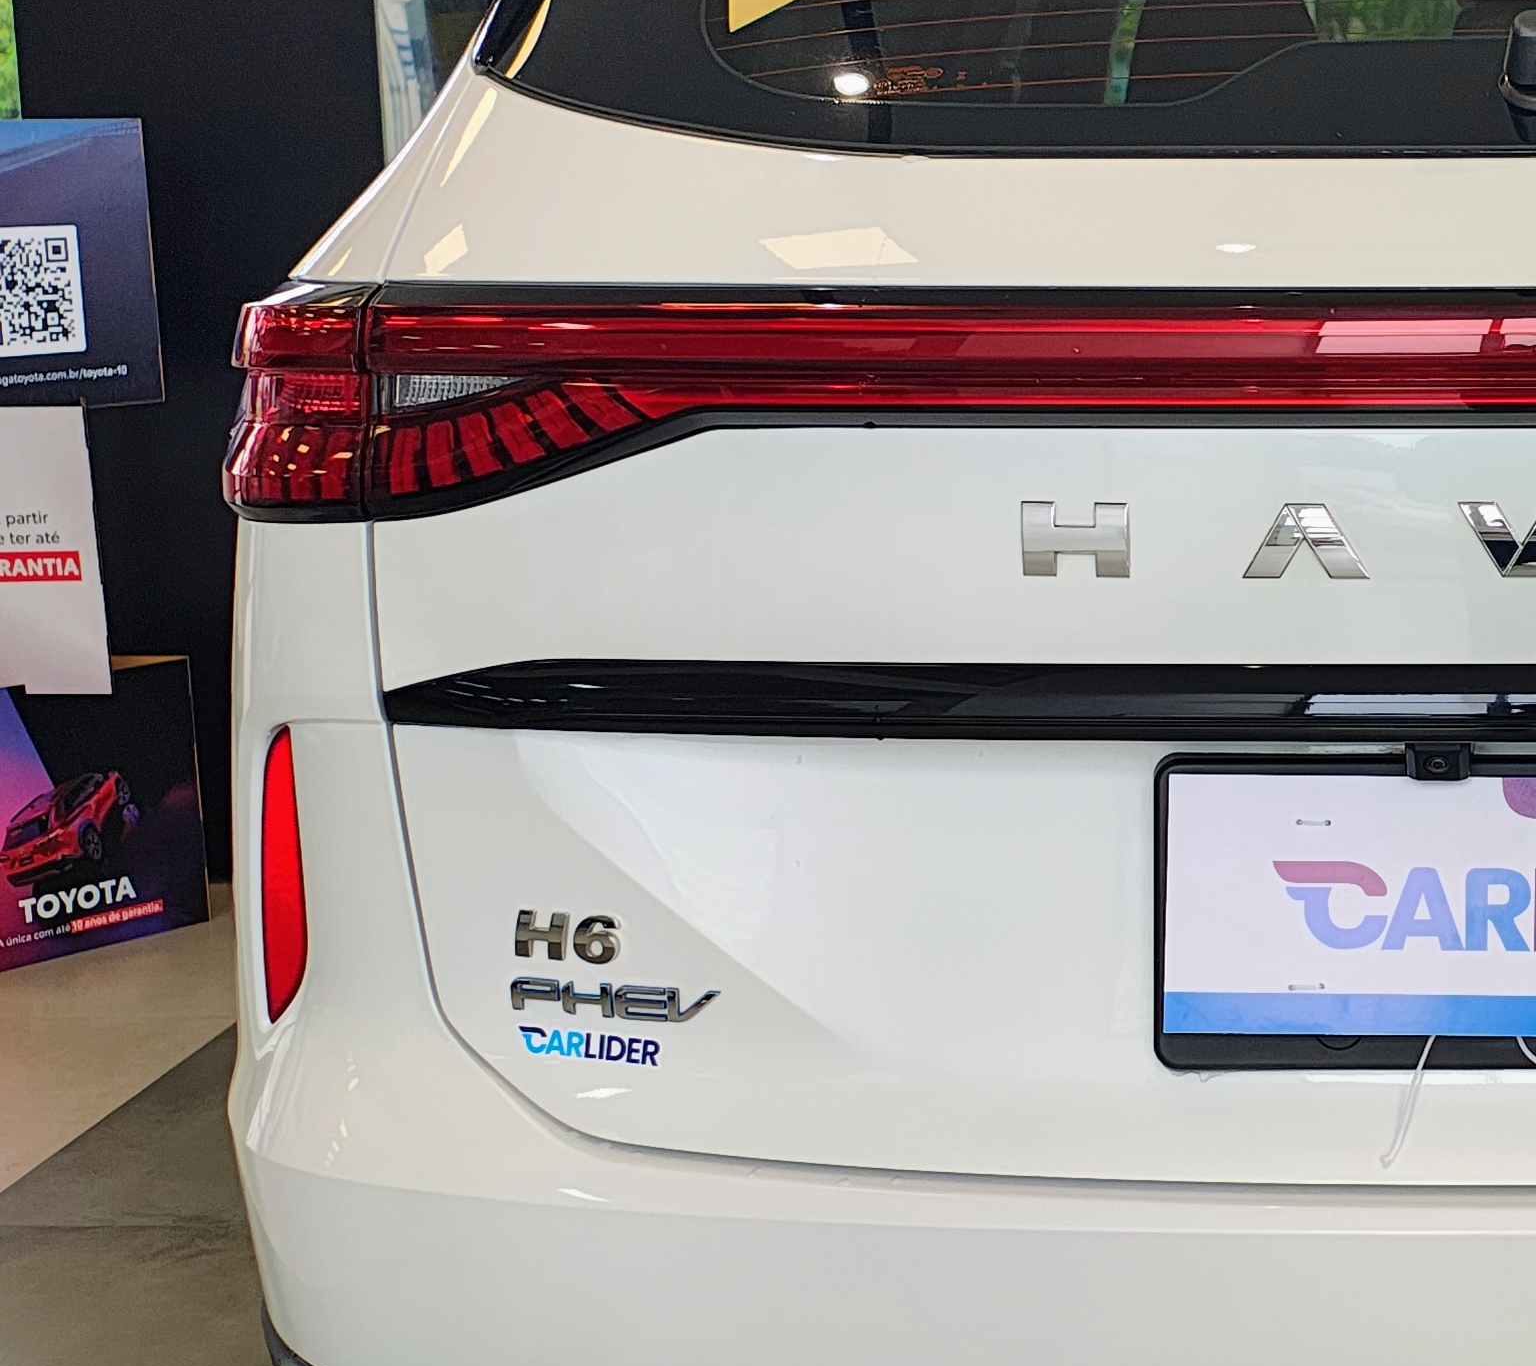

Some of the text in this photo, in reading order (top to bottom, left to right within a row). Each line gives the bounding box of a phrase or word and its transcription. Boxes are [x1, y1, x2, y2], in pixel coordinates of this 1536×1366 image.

[0, 364, 128, 387] gatoyota.com.br/toyota-10
[5, 510, 49, 529] partir
[9, 532, 31, 545] ter
[35, 530, 60, 545] até
[18, 876, 137, 924] TOYOTA
[6, 931, 32, 947] única
[33, 927, 54, 941] com
[514, 908, 622, 965] H6
[509, 976, 722, 1023] PHEV
[518, 1025, 661, 1067] CARLIDER
